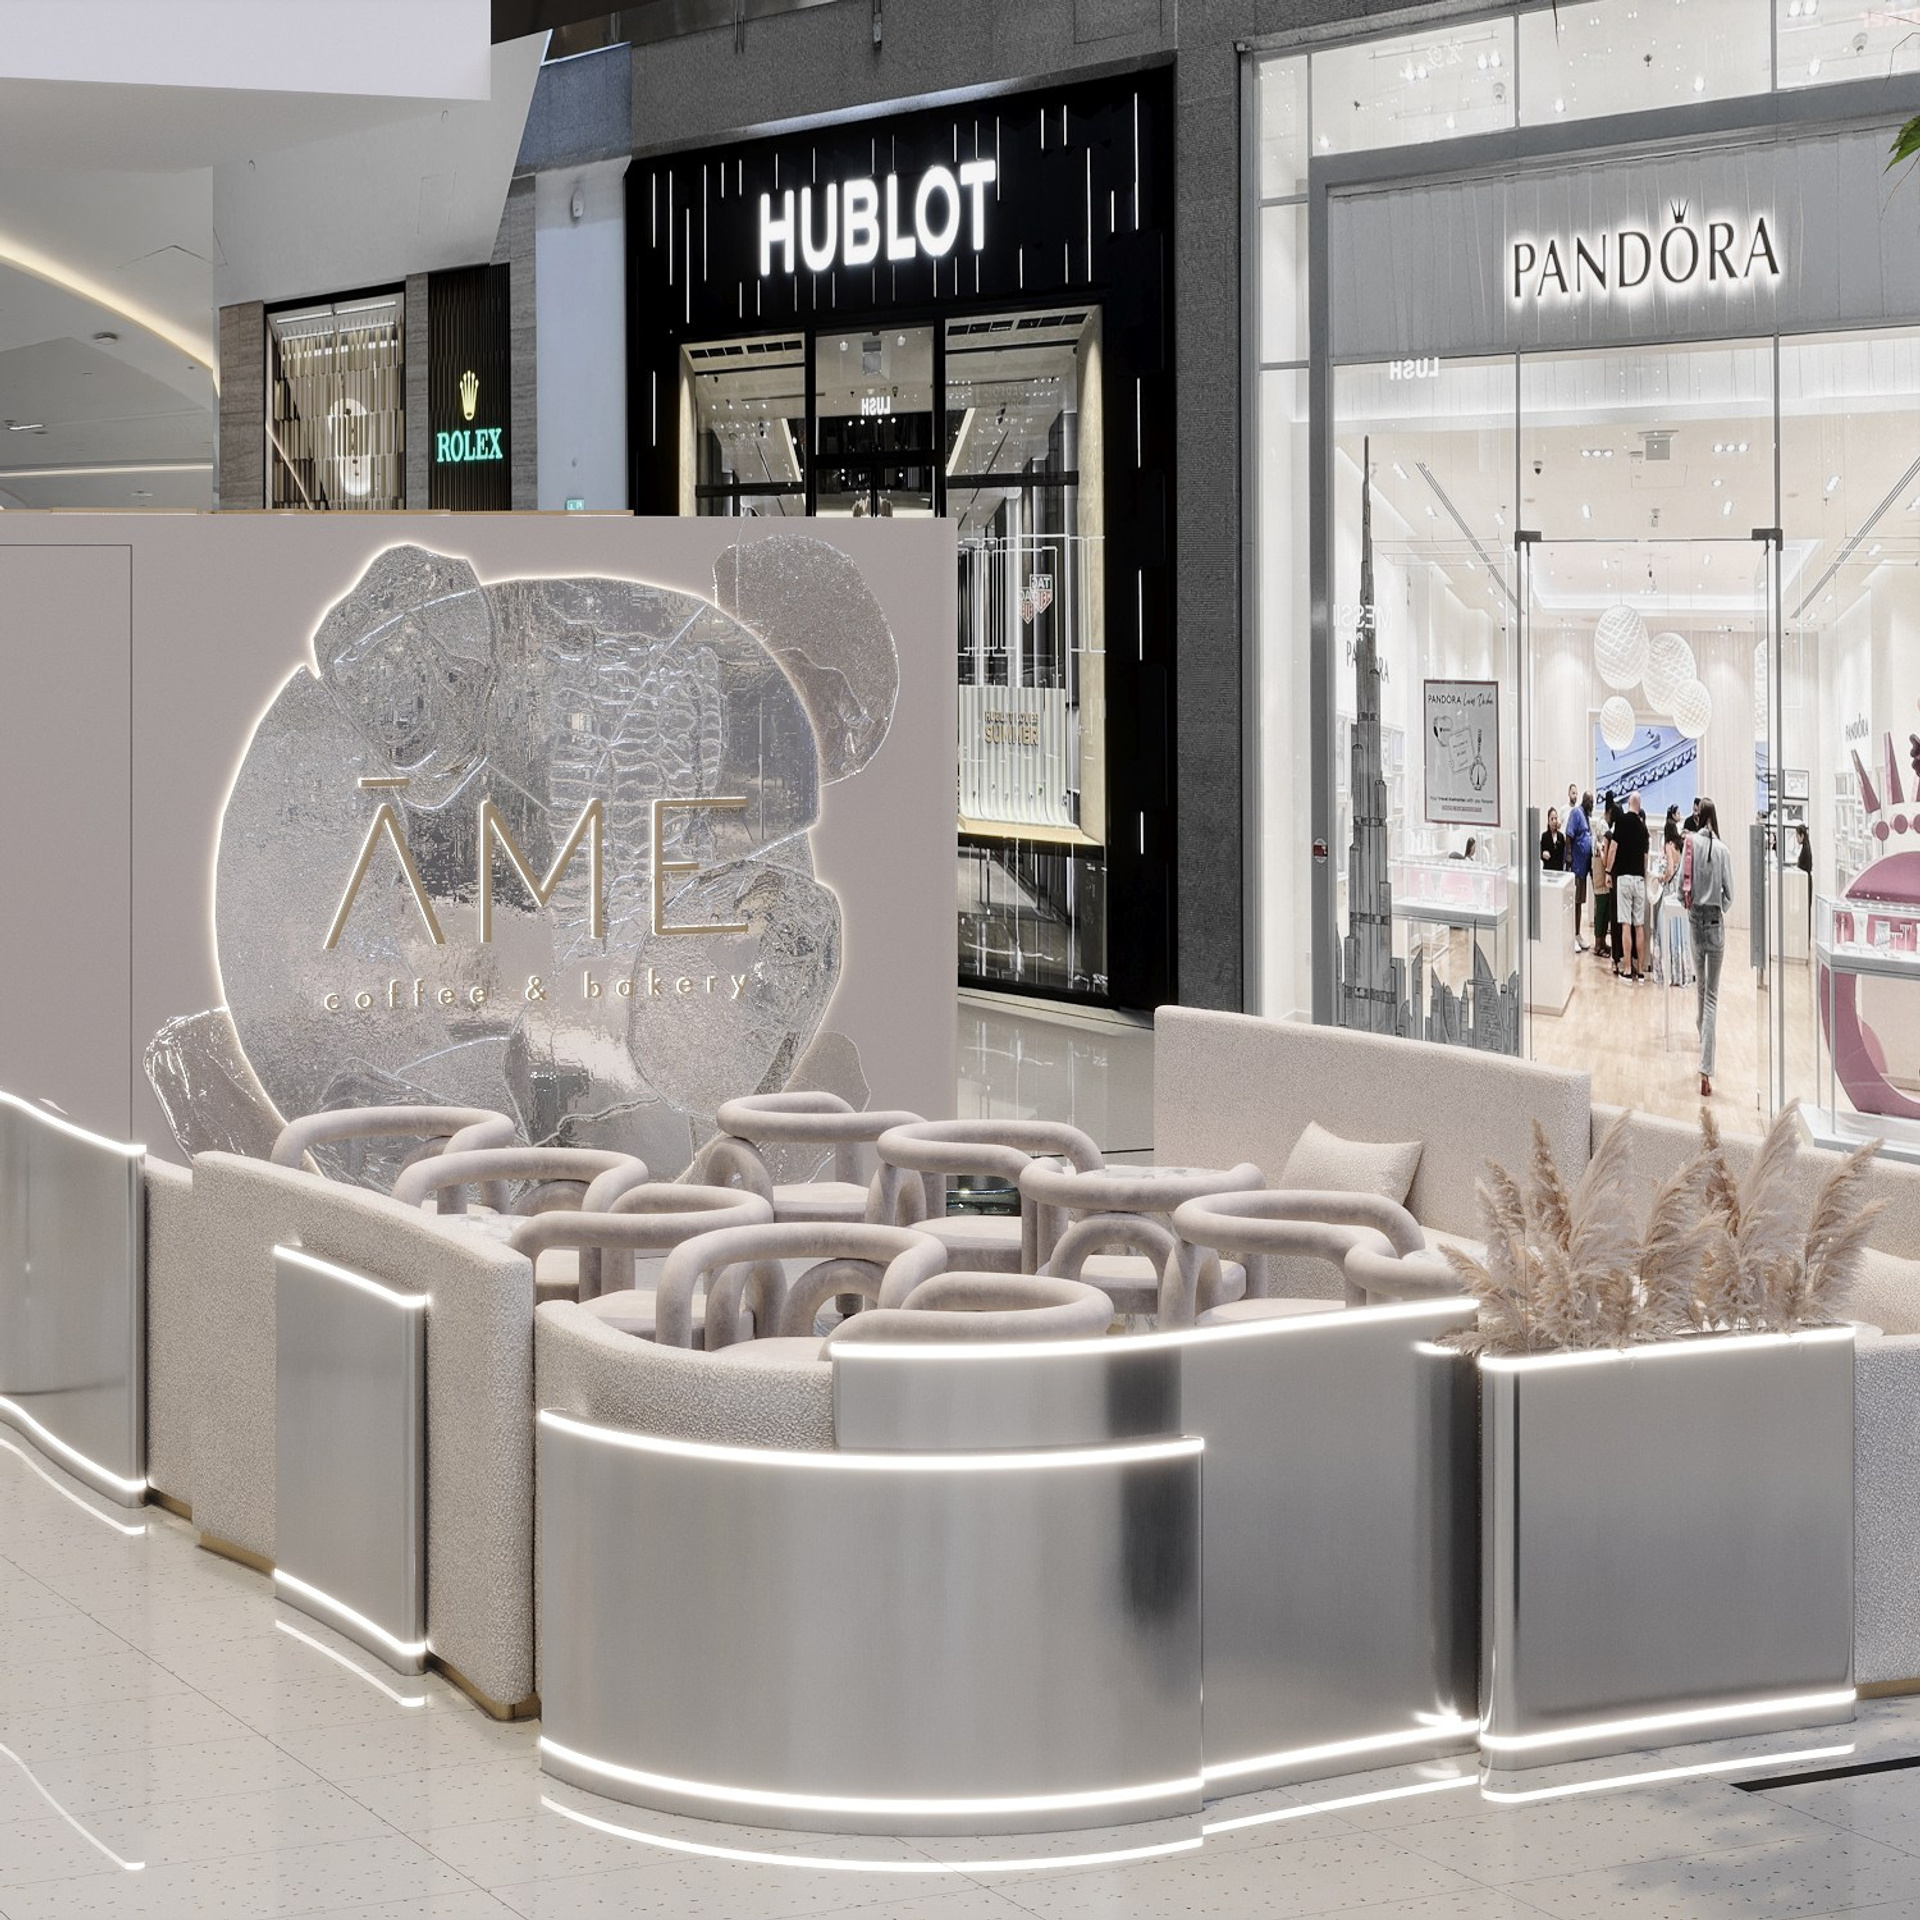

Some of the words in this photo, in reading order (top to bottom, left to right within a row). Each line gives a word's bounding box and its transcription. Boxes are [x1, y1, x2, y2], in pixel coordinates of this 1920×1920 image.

[760, 159, 996, 276] HUBLOT
[1513, 214, 1780, 297] PANDORA
[436, 427, 503, 463] ROLEX
[1428, 694, 1462, 704] PANDORA
[324, 979, 487, 1010] coffee
[525, 975, 547, 1001] &
[583, 968, 751, 1000] bakery
